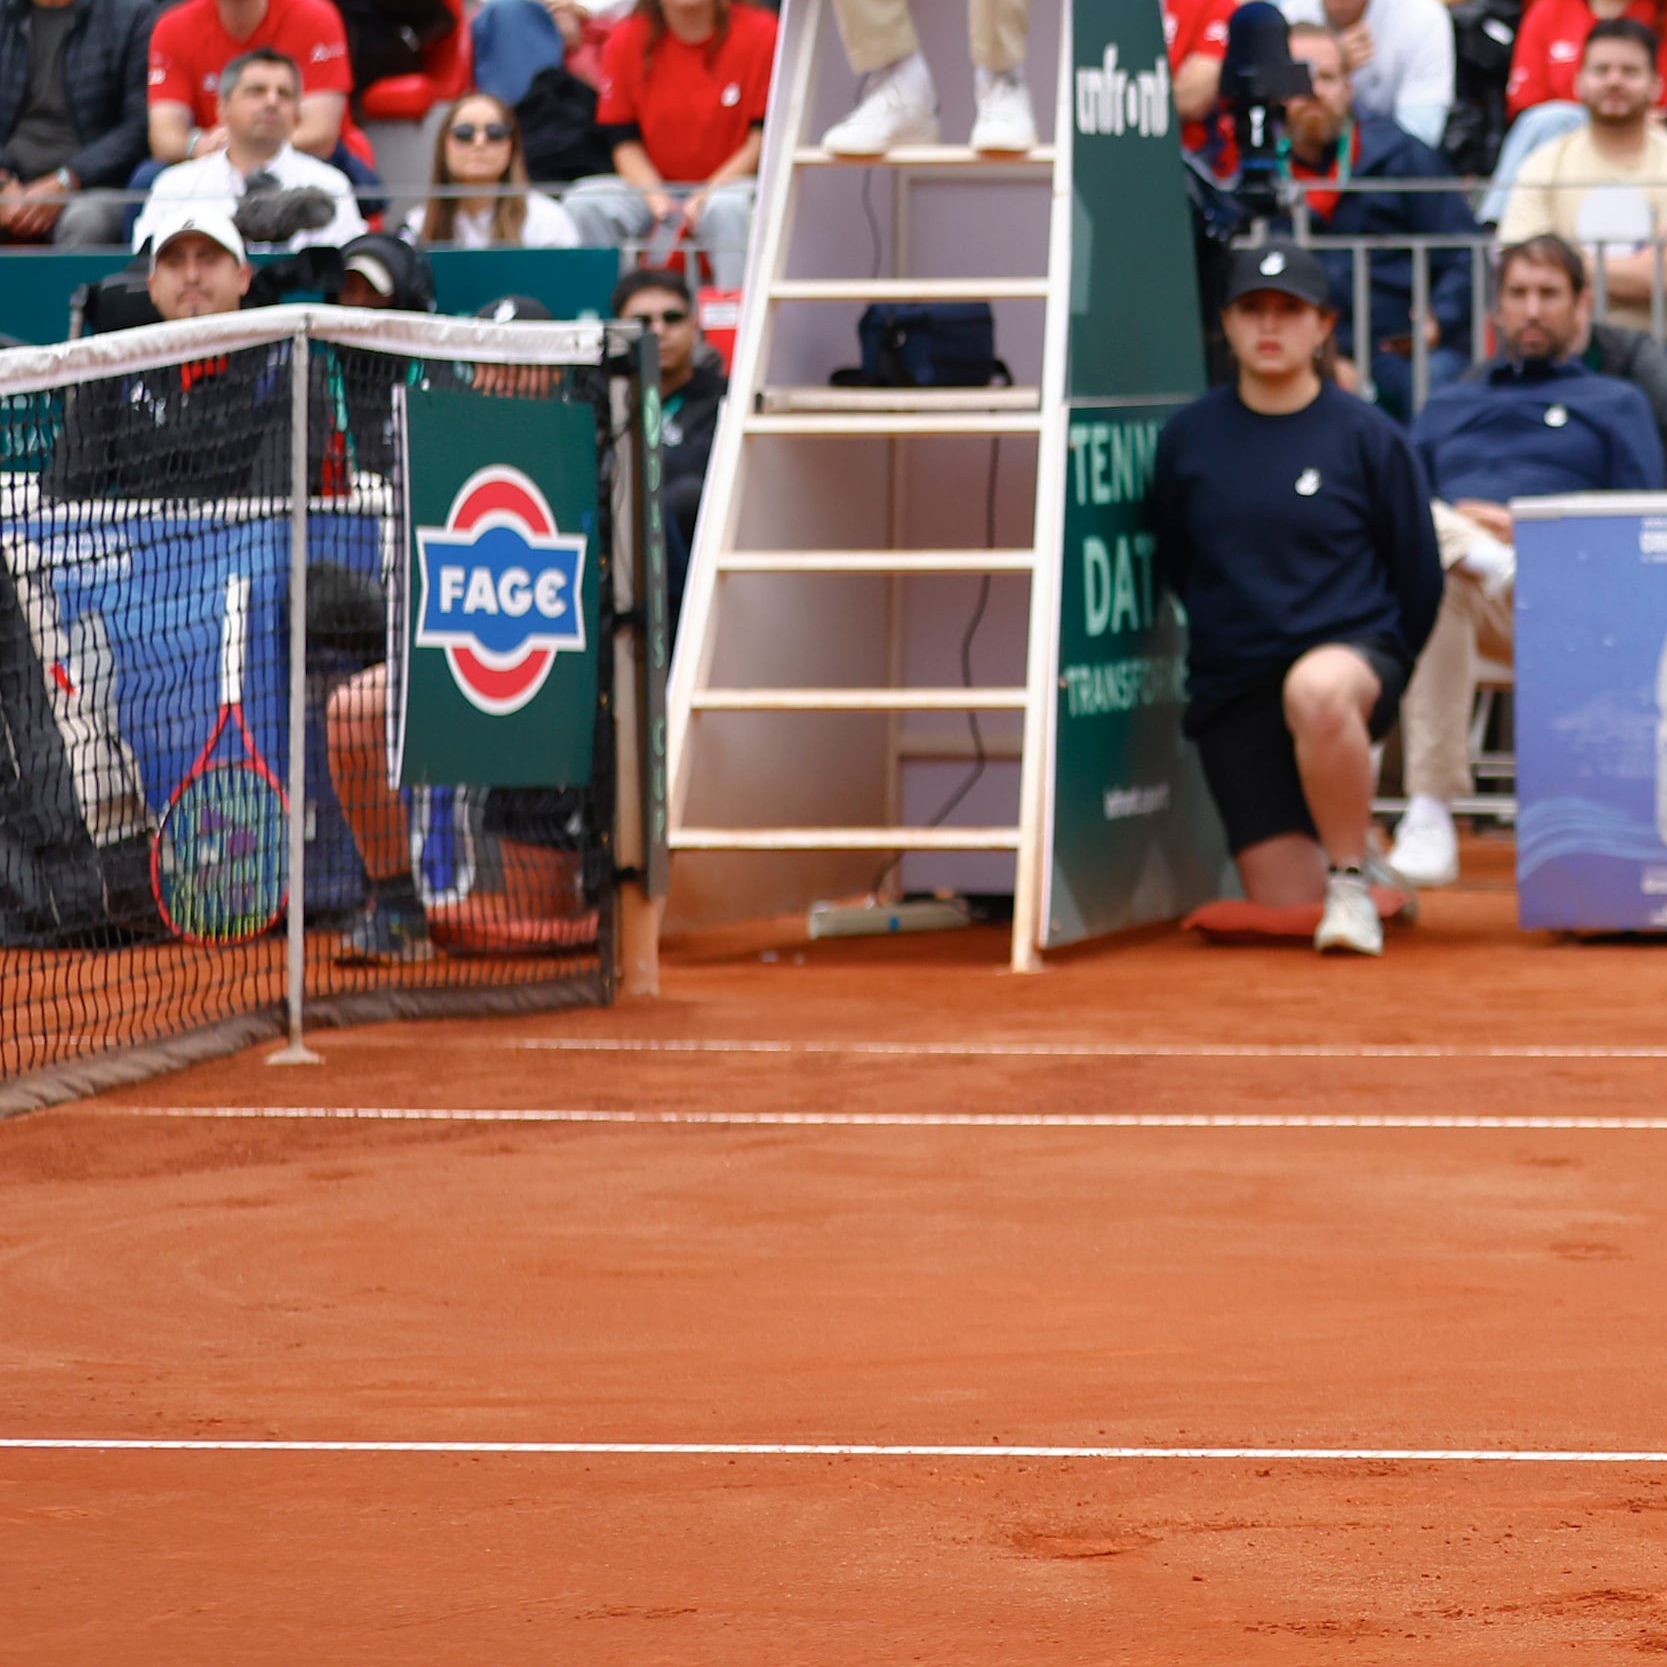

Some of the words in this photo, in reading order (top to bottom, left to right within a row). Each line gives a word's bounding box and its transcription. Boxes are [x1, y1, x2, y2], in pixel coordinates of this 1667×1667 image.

[1068, 421, 1159, 506] TENN
[440, 565, 568, 619] FAGE
[1082, 535, 1157, 637] DAT
